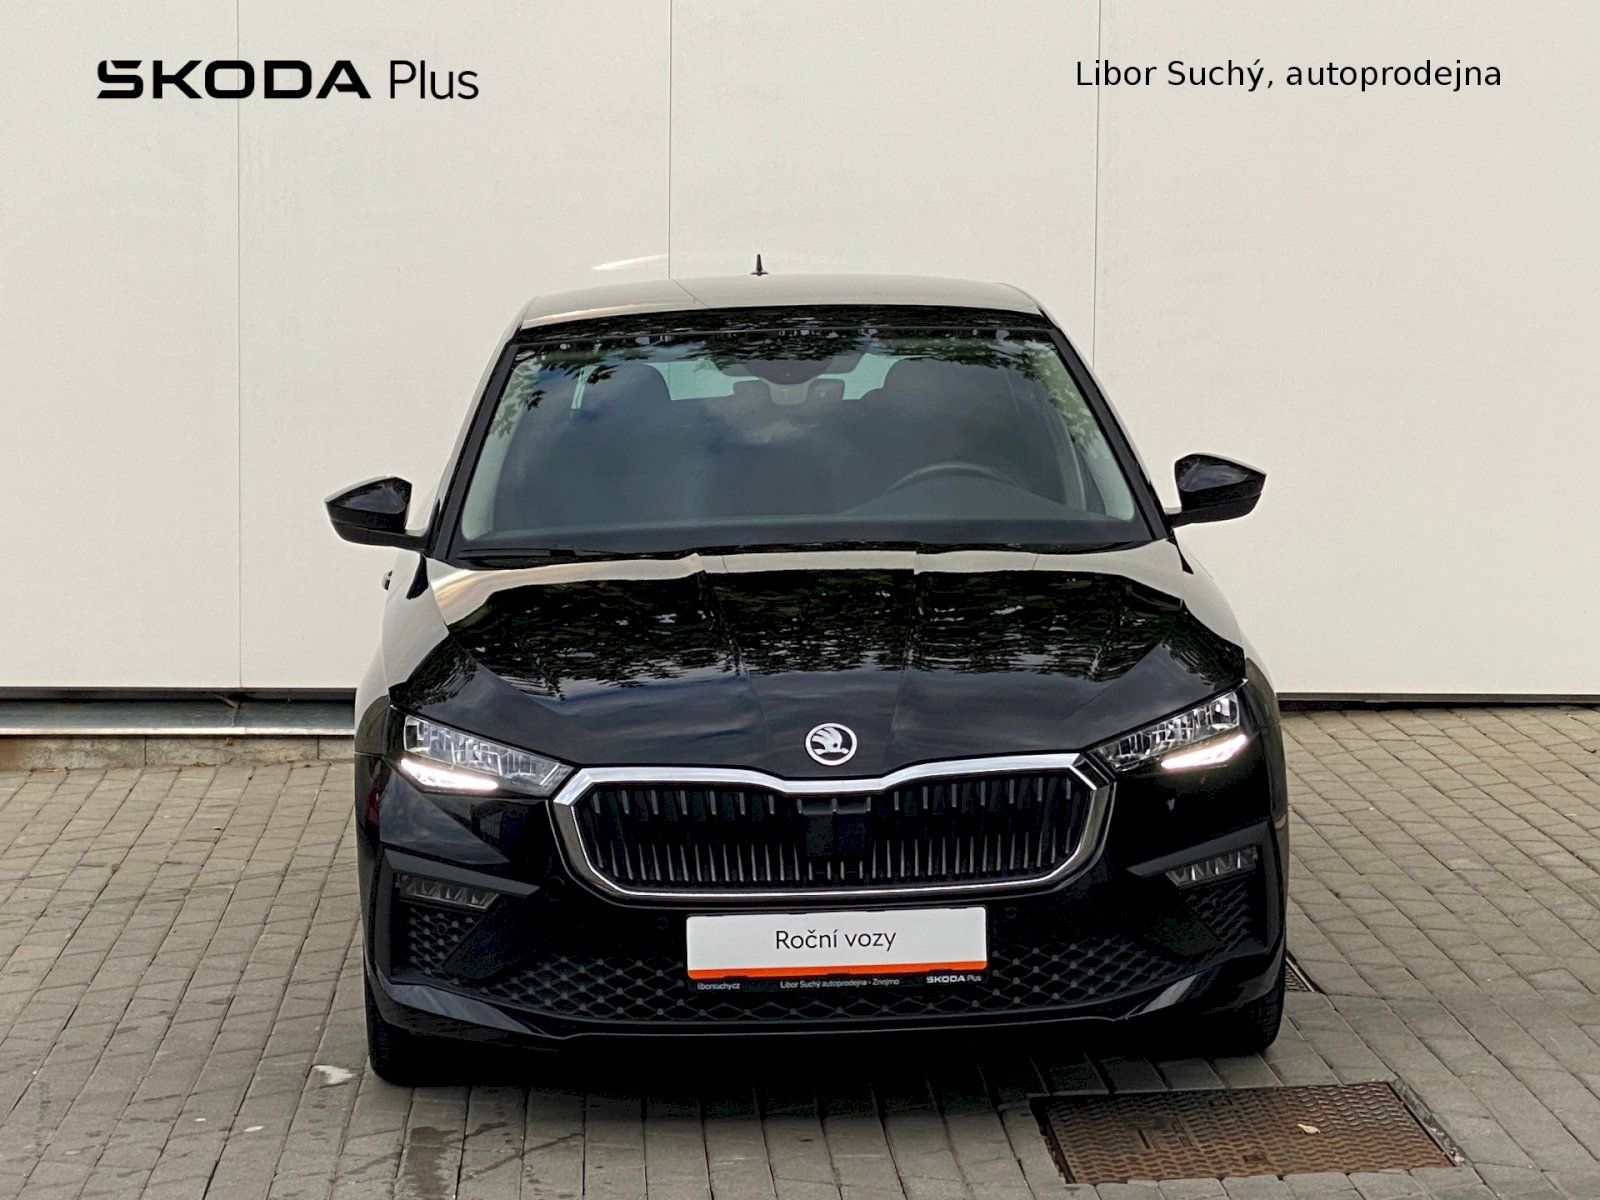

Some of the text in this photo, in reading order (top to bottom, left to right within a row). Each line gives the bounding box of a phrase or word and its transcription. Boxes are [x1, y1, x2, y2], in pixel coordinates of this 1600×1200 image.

[775, 928, 897, 952] Roční vozy
[780, 980, 799, 989] Libor
[872, 978, 900, 987] Znojmo
[966, 974, 982, 983] Plus
